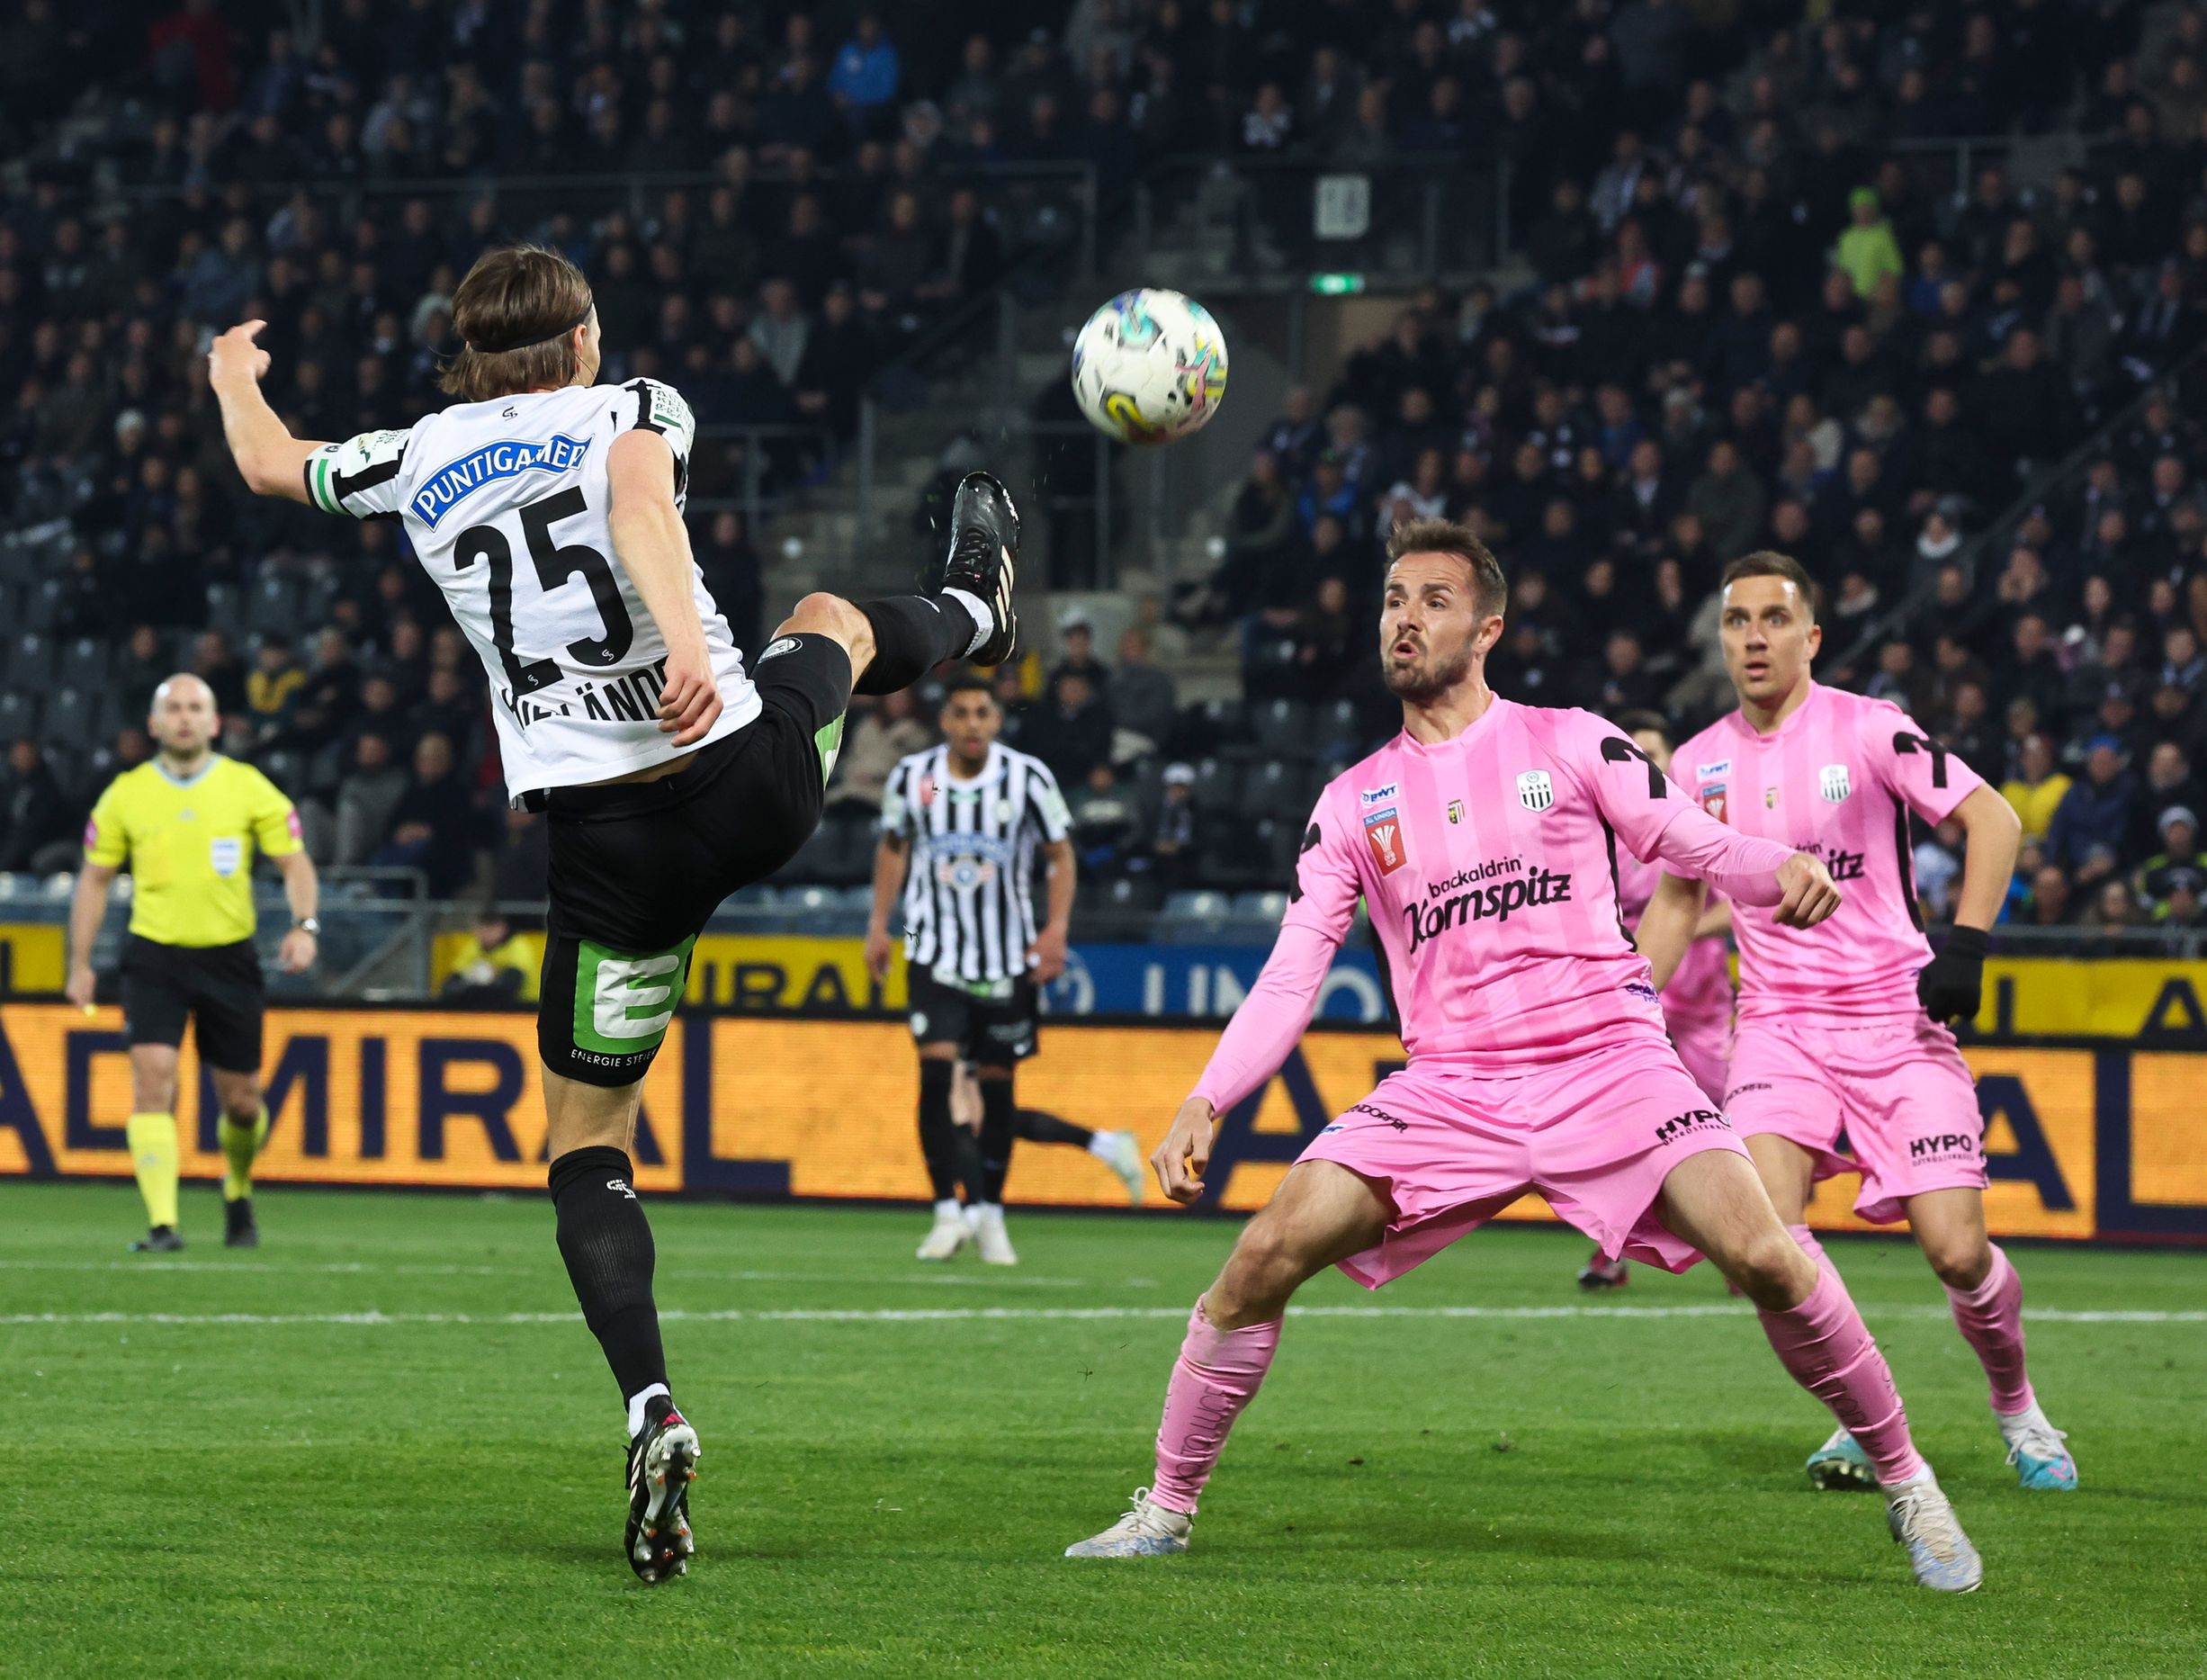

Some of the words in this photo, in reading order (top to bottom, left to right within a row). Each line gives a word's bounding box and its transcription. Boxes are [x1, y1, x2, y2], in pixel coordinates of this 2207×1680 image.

[454, 485, 633, 696] 25
[1521, 784, 1549, 792] LASK
[1429, 857, 1521, 899] backaldrin
[1404, 866, 1572, 955] Kornspitz
[570, 1048, 622, 1067] ENERGIE
[1909, 1134, 1972, 1158] HYPO
